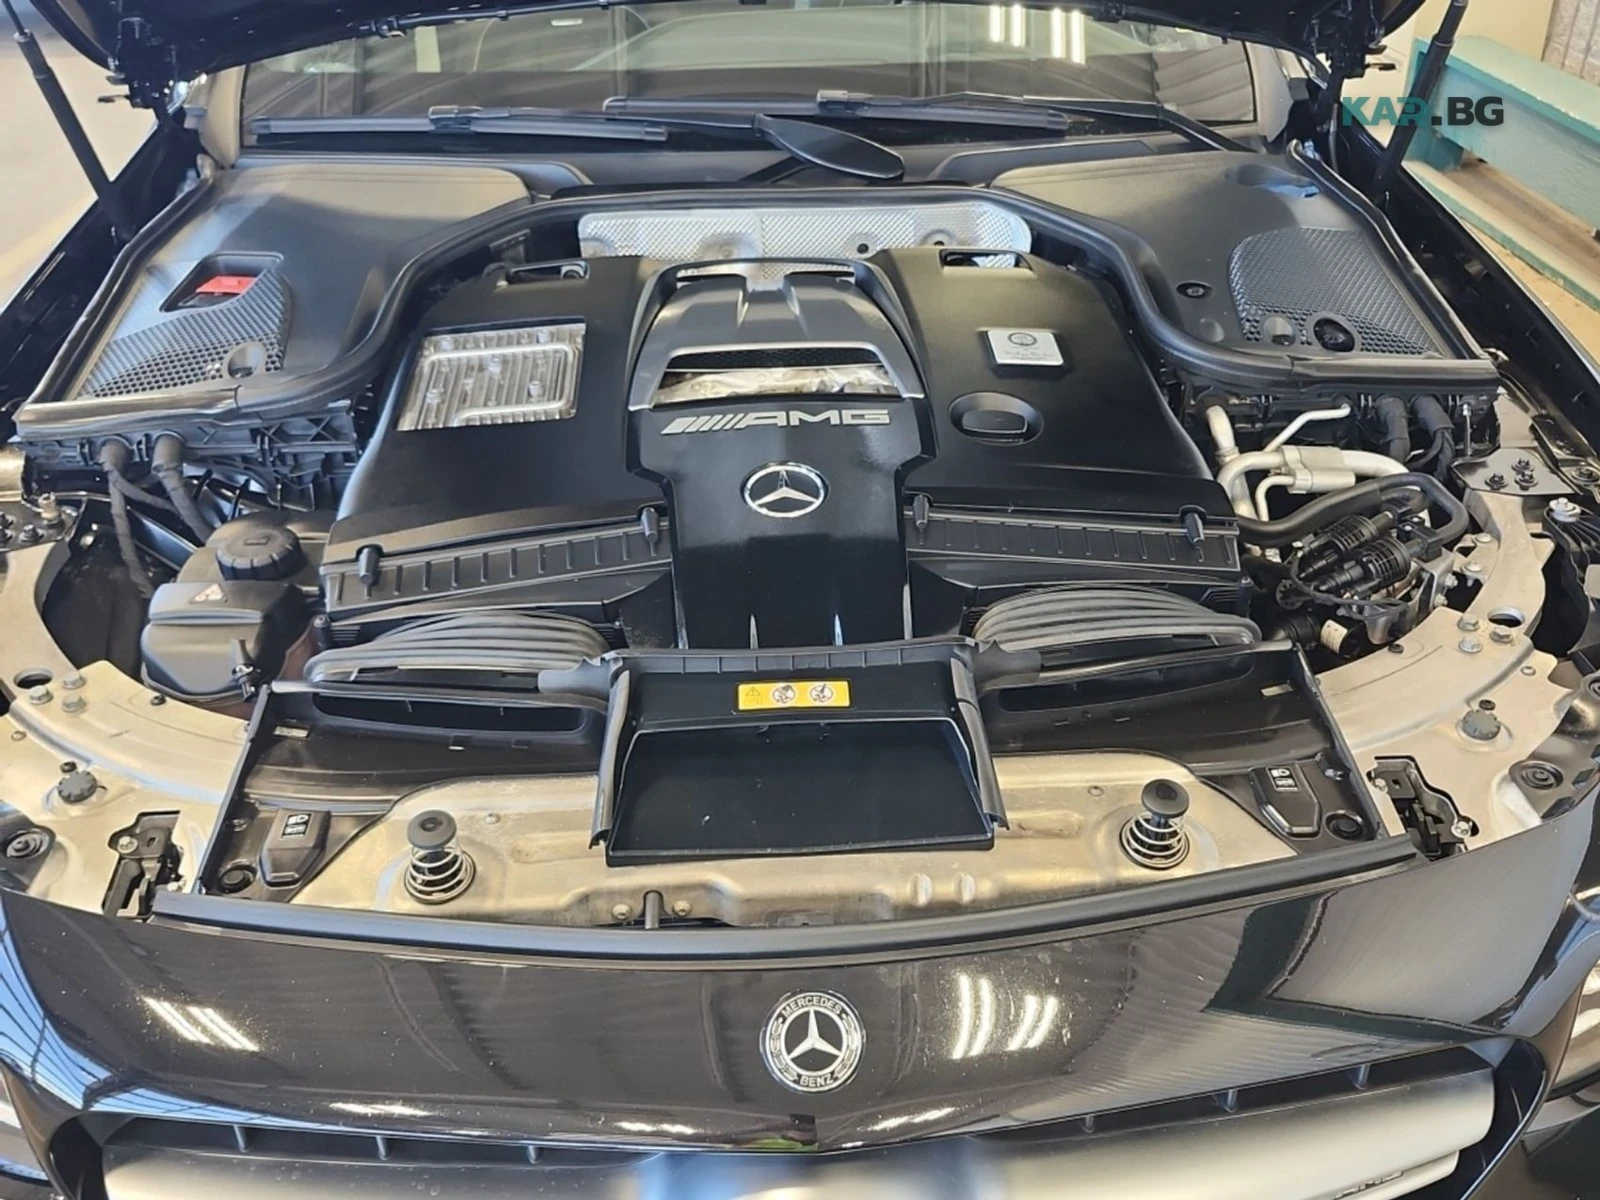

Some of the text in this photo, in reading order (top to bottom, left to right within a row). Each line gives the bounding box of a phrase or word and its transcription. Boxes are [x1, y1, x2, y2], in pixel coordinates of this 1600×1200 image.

[734, 410, 890, 429] AMG
[782, 996, 842, 1017] MERCEDES
[800, 1074, 835, 1088] BENZ
